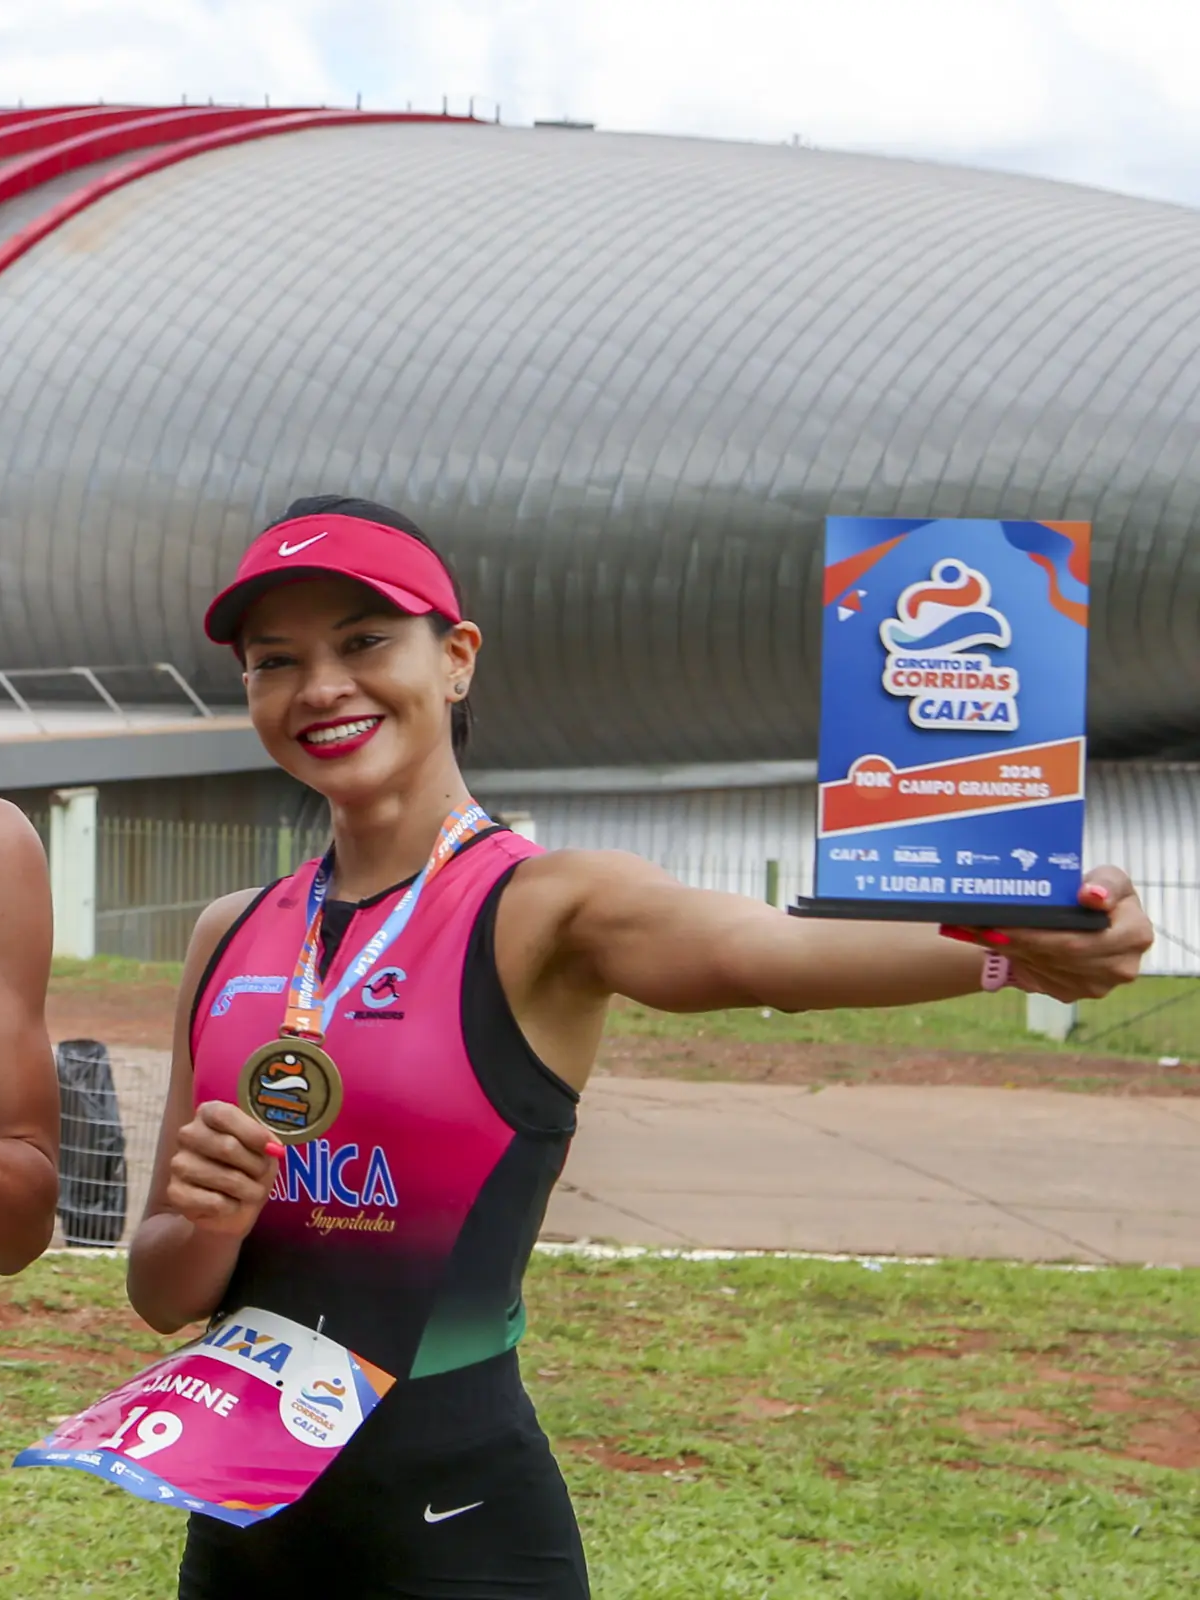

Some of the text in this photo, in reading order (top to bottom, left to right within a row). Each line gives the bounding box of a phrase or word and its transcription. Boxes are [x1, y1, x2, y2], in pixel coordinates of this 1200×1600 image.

[895, 658, 982, 670] CIRCUITO DE
[892, 671, 1011, 690] CORRIDAS
[918, 699, 1009, 722] CAIXA
[855, 771, 892, 787] 10K
[999, 765, 1042, 779] 2024
[898, 779, 1050, 798] CAMPO GRANDE-MS
[829, 848, 879, 861] CAIXA
[881, 876, 945, 893] LUGAR
[952, 877, 1052, 897] FEMININO
[305, 1206, 397, 1236] Importados
[143, 1374, 239, 1418] JANINE
[291, 1401, 335, 1431] CORRIDAS
[98, 1406, 183, 1460] 19
[292, 1416, 327, 1441] CAIXA
